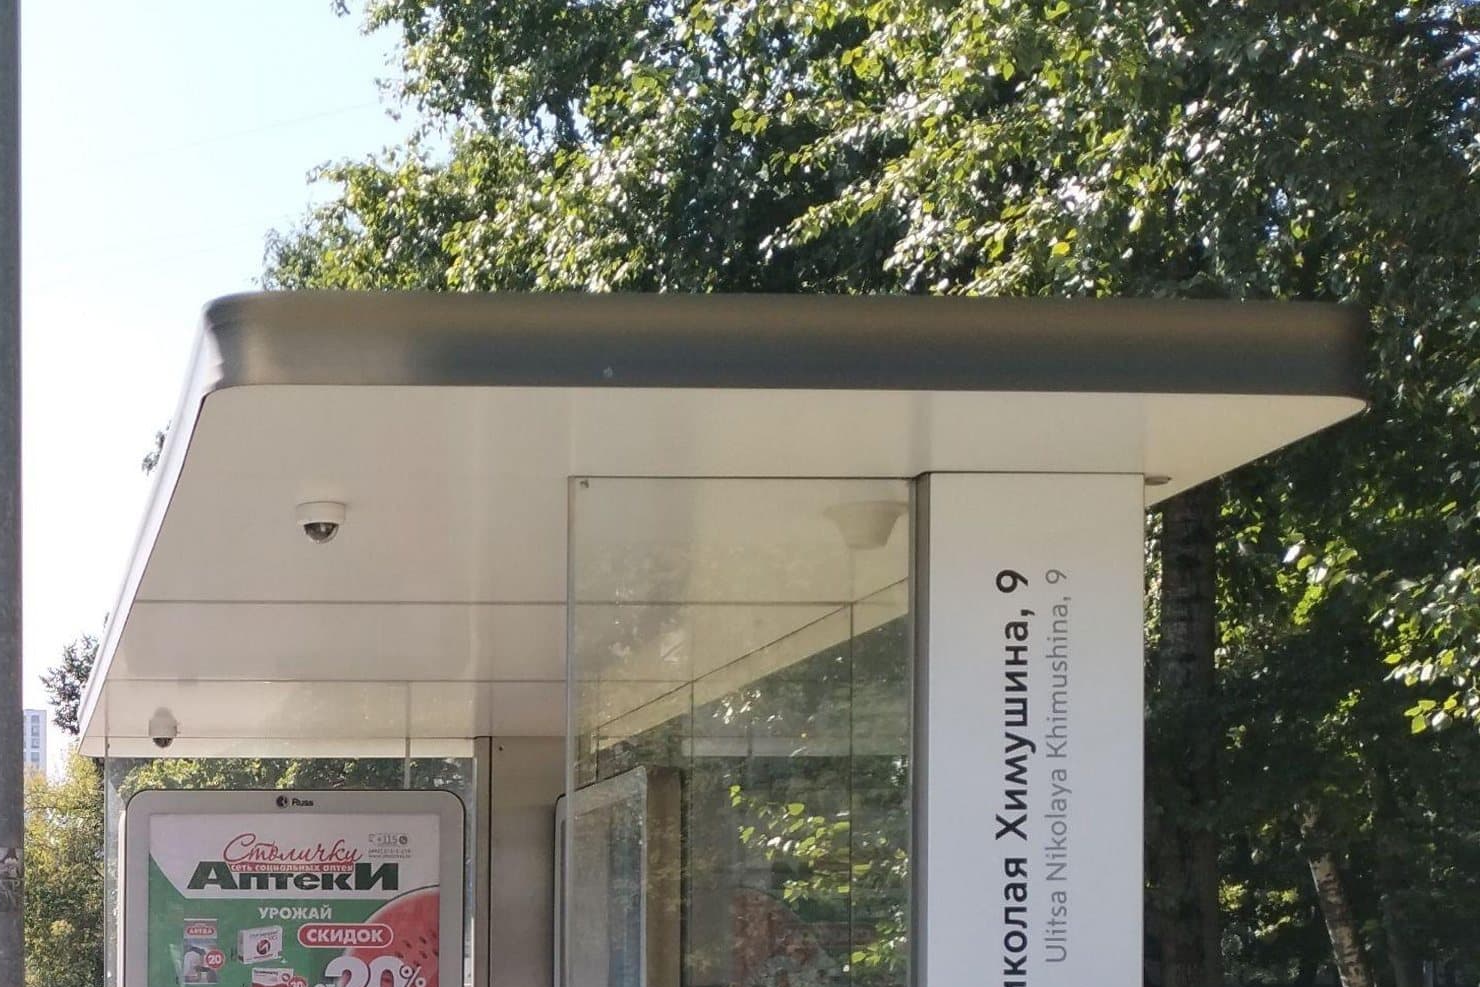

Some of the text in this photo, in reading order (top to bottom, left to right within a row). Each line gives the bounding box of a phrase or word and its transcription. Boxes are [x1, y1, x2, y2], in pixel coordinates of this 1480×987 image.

[995, 569, 1029, 594] 9
[995, 608, 1037, 841] Химушина,
[1043, 569, 1072, 963] Ulitsa Nikolaya Khimushina, 9
[259, 904, 332, 920] УРОЖАЙ
[306, 929, 384, 945] СКИДОК
